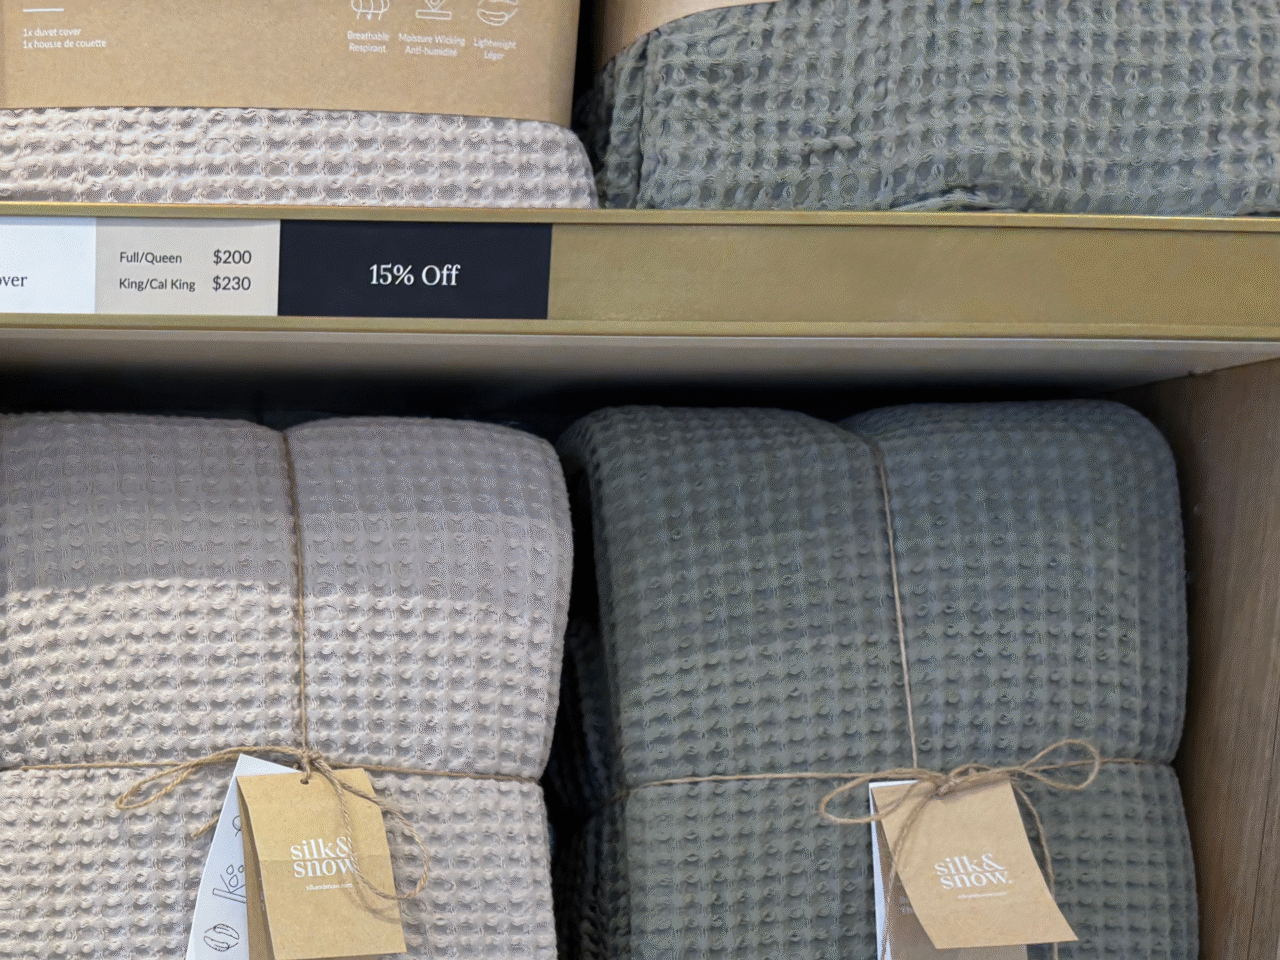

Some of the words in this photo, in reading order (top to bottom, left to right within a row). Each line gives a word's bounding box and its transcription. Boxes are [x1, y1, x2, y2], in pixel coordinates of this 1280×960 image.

[64, 39, 74, 48] de
[119, 250, 183, 265] Full/Queen
[212, 248, 252, 266] $200
[119, 277, 168, 292] King/Cal
[170, 278, 196, 293] King
[211, 275, 251, 293] $230
[369, 263, 414, 286] 15%
[421, 263, 461, 286] Off
[290, 836, 351, 860] silk&
[934, 853, 1006, 876] silk&
